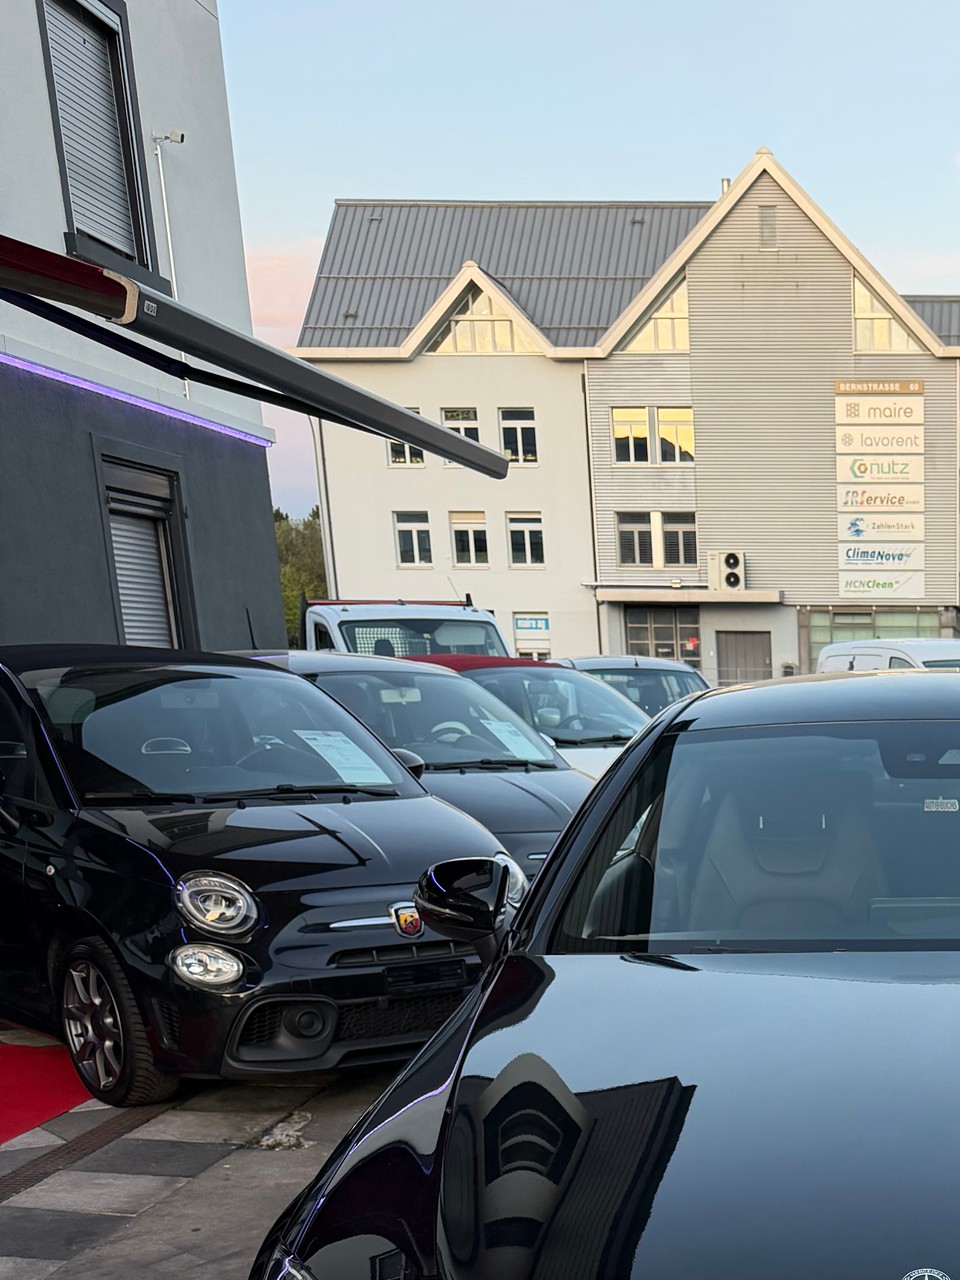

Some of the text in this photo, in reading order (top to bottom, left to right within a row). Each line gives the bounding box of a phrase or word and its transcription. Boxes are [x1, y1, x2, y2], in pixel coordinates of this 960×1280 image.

[839, 383, 901, 391] BERNSTRASSE
[867, 402, 914, 418] maire
[860, 433, 920, 447] lavorent
[844, 579, 894, 589] HCNClean
